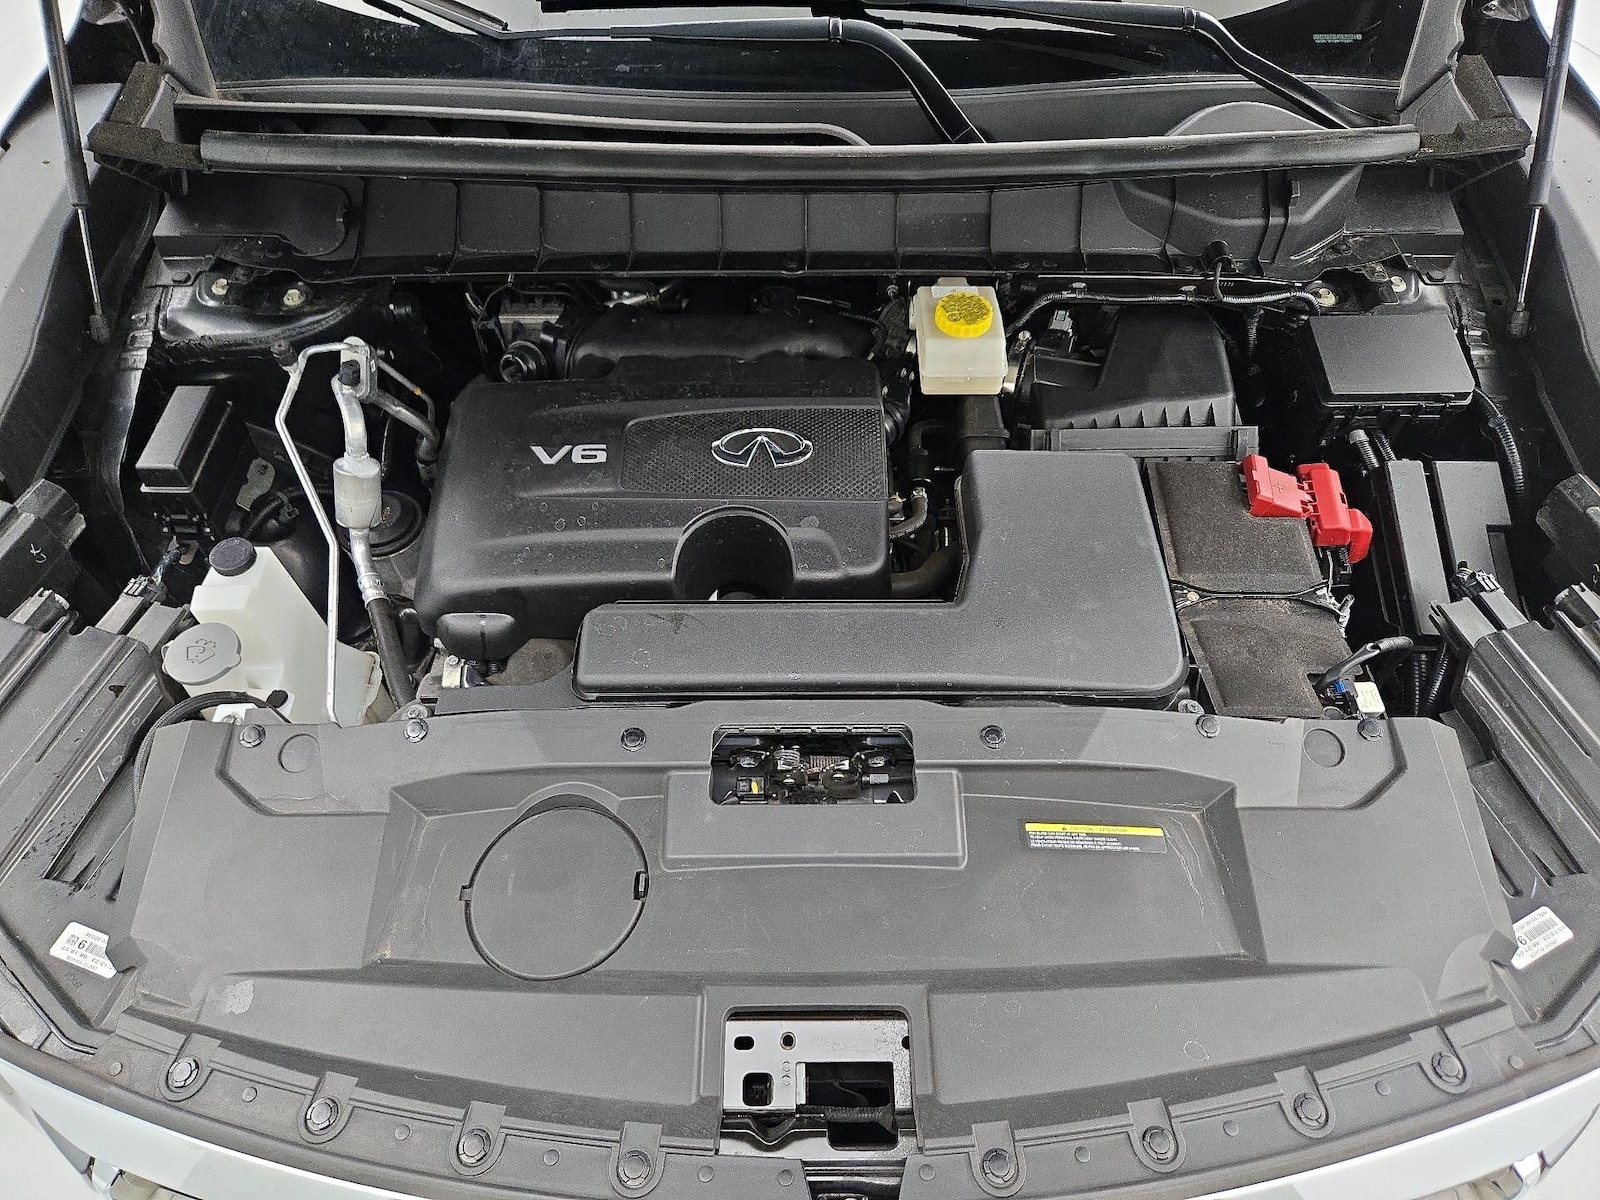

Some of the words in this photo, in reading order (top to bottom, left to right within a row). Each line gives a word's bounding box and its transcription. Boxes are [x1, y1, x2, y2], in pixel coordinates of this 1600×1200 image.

[529, 443, 609, 466] V6
[77, 939, 87, 950] 9
[1517, 935, 1527, 946] 9
